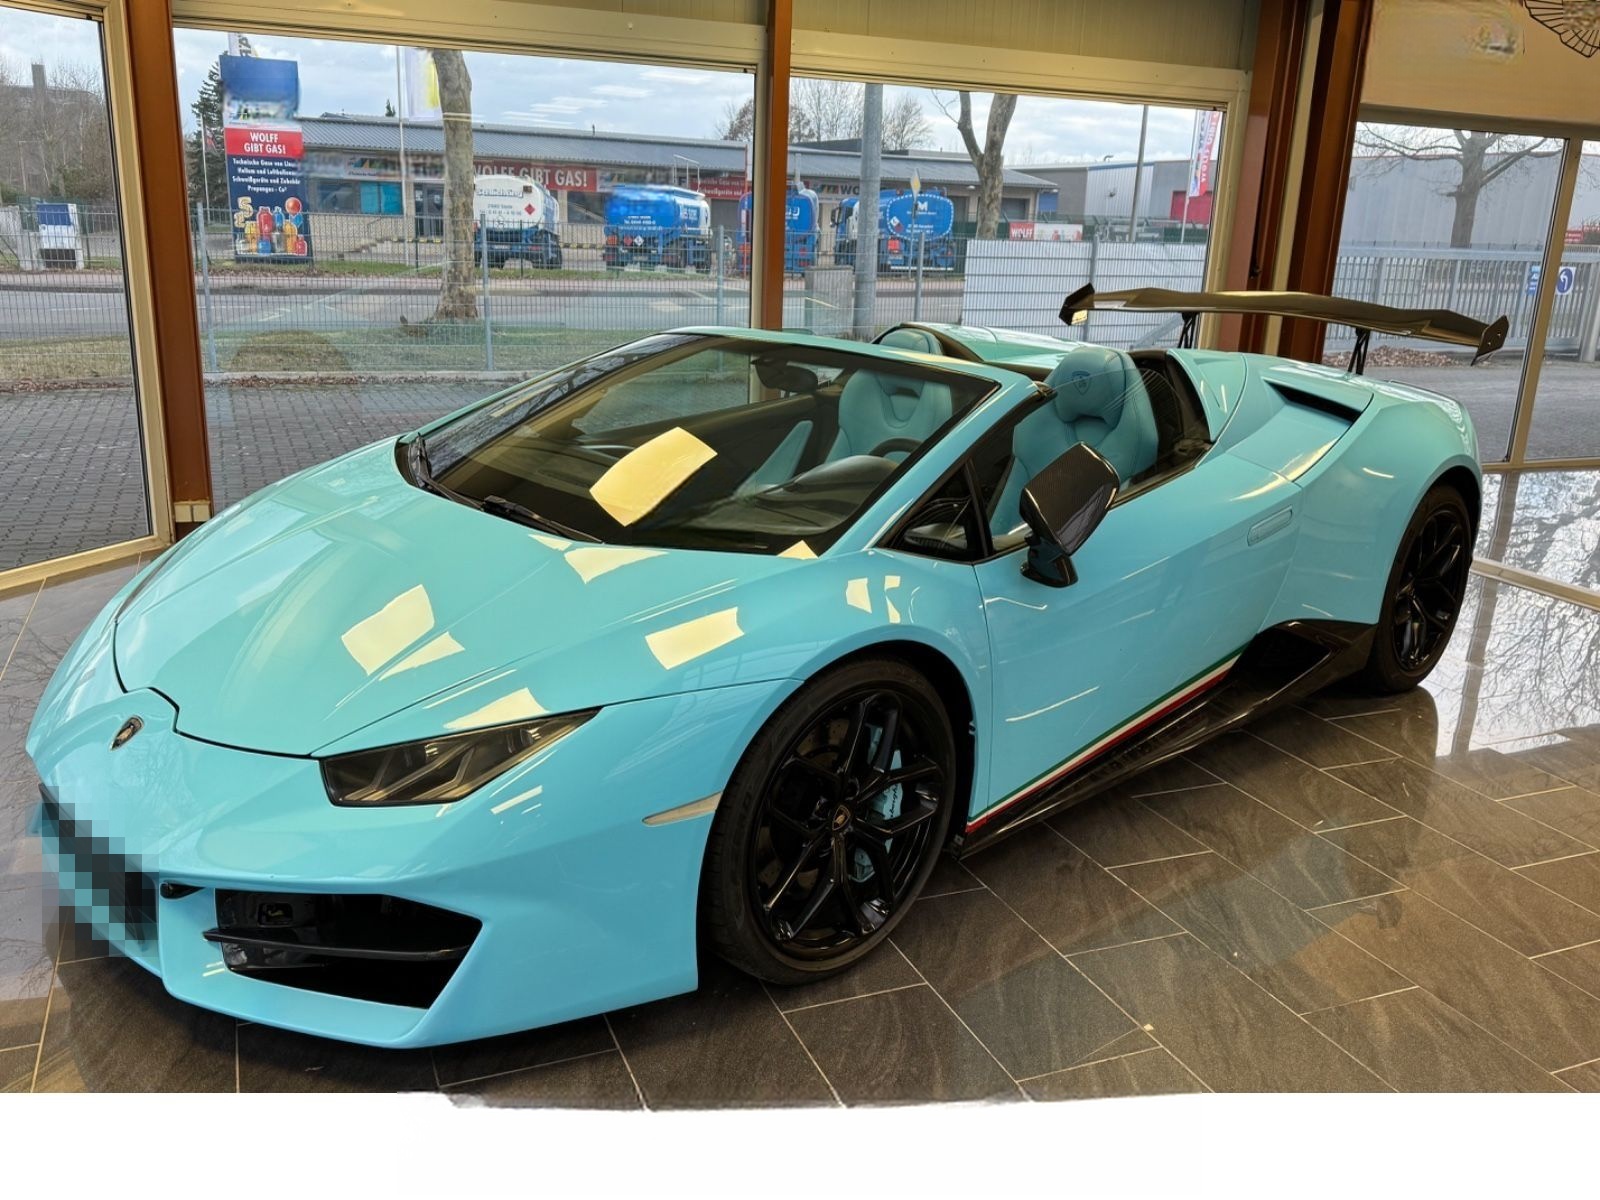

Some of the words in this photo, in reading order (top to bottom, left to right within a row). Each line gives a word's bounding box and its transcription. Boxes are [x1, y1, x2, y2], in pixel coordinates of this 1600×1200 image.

[250, 132, 279, 143] WOLFF
[243, 142, 264, 153] GIBT
[265, 144, 287, 154] GAS!
[554, 170, 588, 187] GAS!
[1011, 227, 1033, 239] WOLFF
